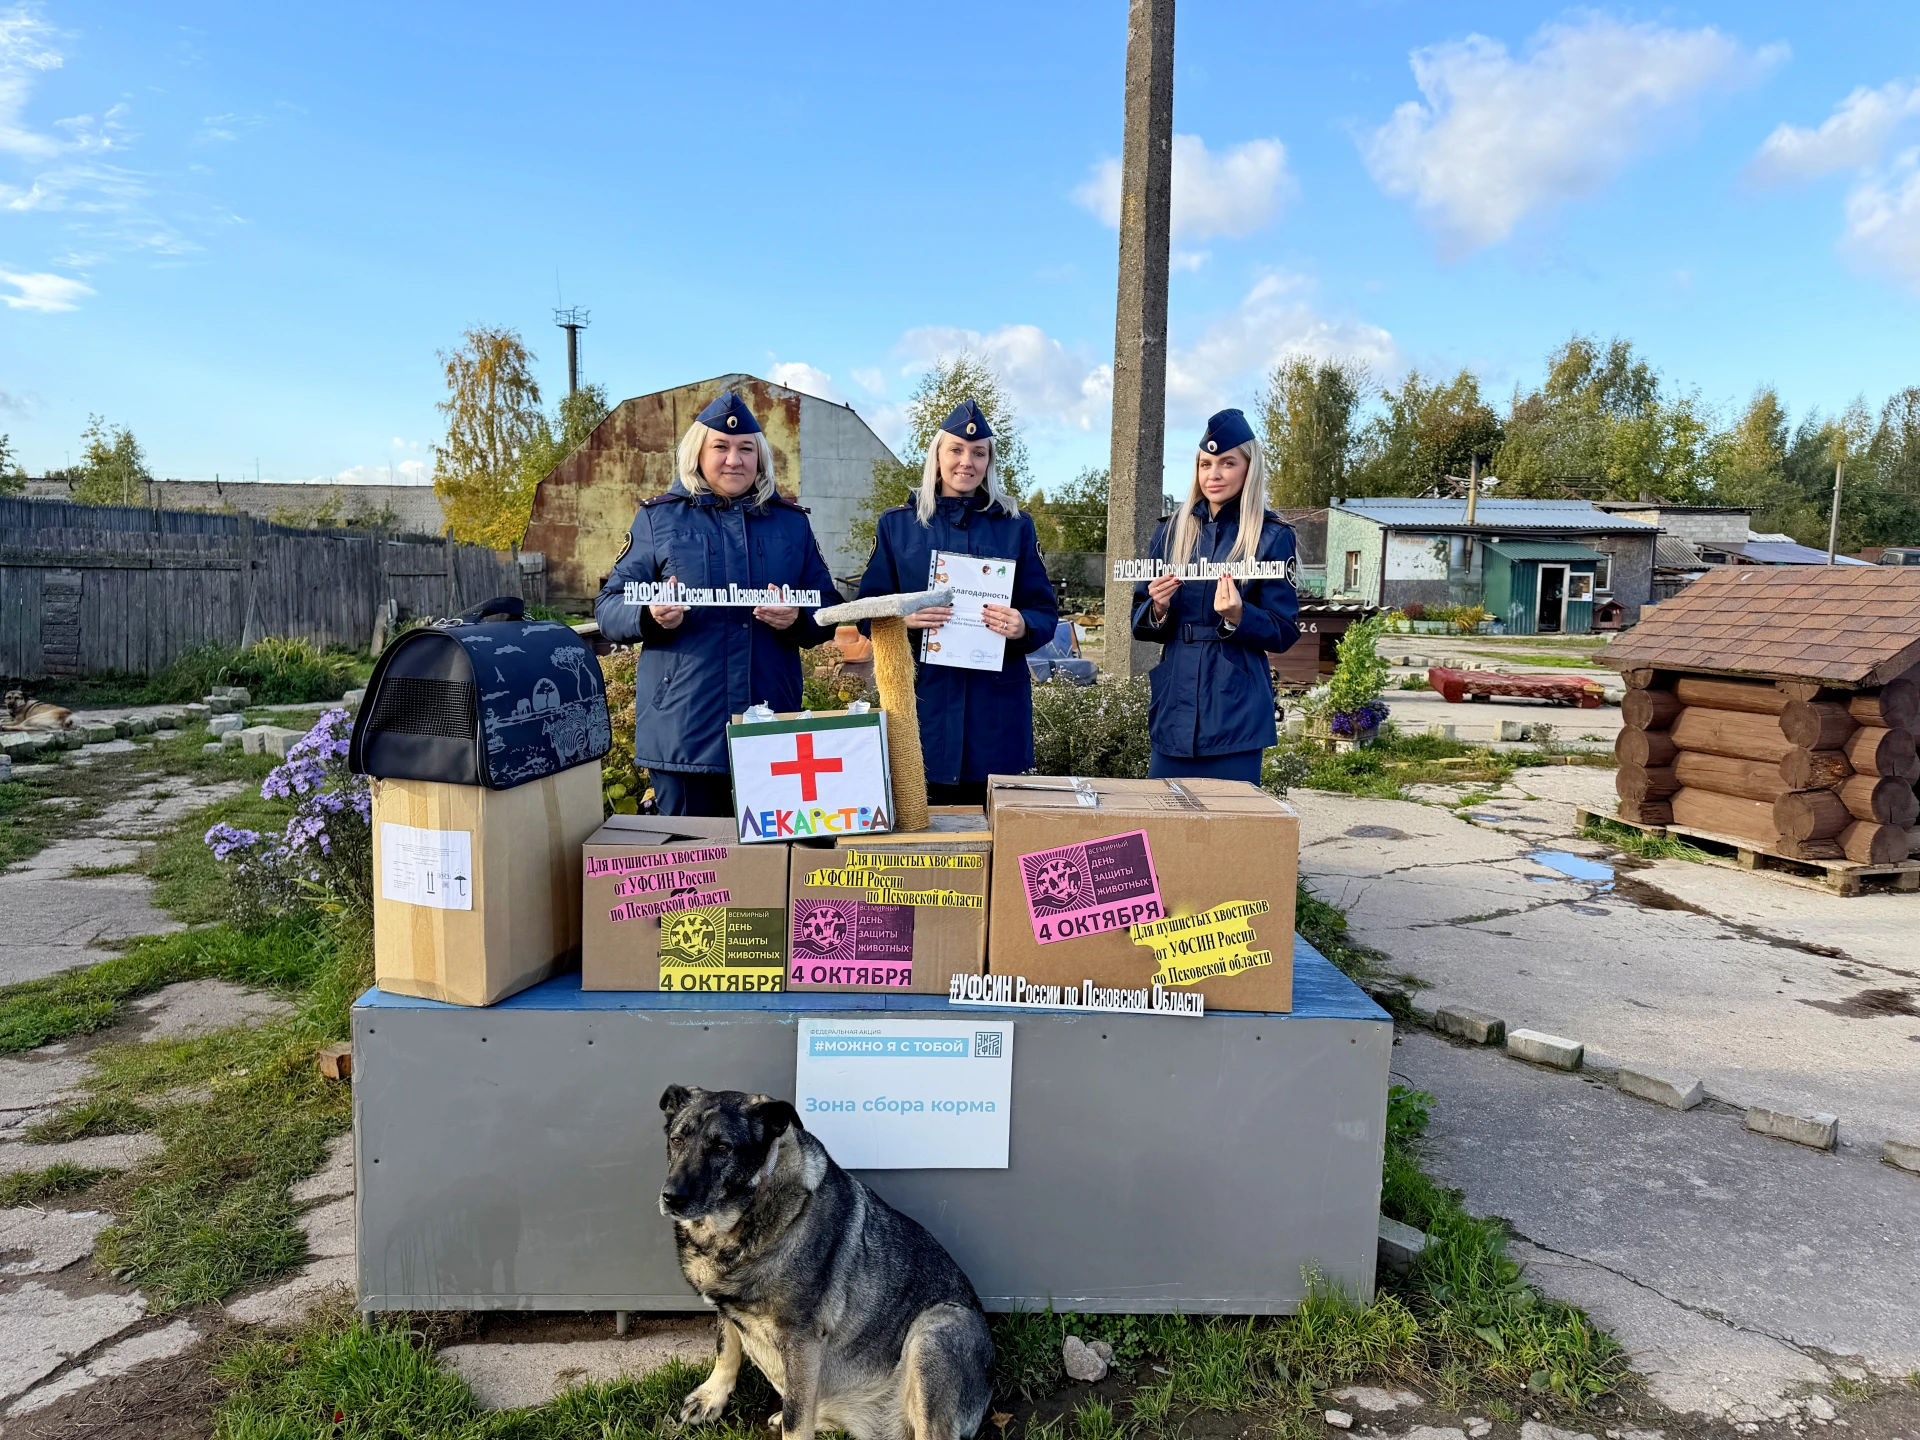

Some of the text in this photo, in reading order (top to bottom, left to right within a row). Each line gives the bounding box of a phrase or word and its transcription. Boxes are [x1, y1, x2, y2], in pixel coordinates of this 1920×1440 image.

[1113, 558, 1155, 578] #УФСИН
[624, 581, 675, 602] #УФСИН
[951, 586, 1009, 600] Благодарность
[741, 805, 890, 838] ЛЕКАРСТВА
[1088, 840, 1129, 855] ВСЕМИРНЫЙ
[586, 847, 728, 875] Для пушистых хвостиков
[846, 850, 982, 871] Для пушистых хвостиков
[1091, 856, 1115, 870] ДЕНЬ
[614, 870, 716, 896] от УФСИН России
[804, 870, 904, 888] от УФСИН России
[1093, 867, 1134, 882] ЗАЩИТЫ
[1096, 878, 1150, 896] ЖИВОТНЫХ
[610, 889, 731, 922] по Псковской области
[866, 888, 983, 908] по Псковской области
[727, 923, 753, 932] ДЕНЬ
[858, 916, 883, 925] ДЕНЬ
[1038, 901, 1161, 941] 4 ОКТЯБРЯ
[1133, 900, 1269, 942] Для пушистых хвостиков
[727, 937, 768, 946] ЗАЩИТЫ
[858, 930, 898, 939] ЗАЩИТЫ
[858, 944, 909, 953] ЖИВОТНЫХ
[1155, 929, 1255, 960] от УФСИН России
[727, 951, 780, 959] ЖИВОТНЫХ
[791, 966, 912, 986] 4 ОКТЯБРЯ
[1168, 956, 1227, 984] Псковской
[1229, 951, 1272, 970] области
[661, 974, 784, 991] 4 ОКТЯБРЯ
[949, 973, 1012, 1001] #УФСИН
[814, 1040, 963, 1053] #МОЖНО Я С ТОБОЙ
[805, 1096, 996, 1115] Зона сбора корма
